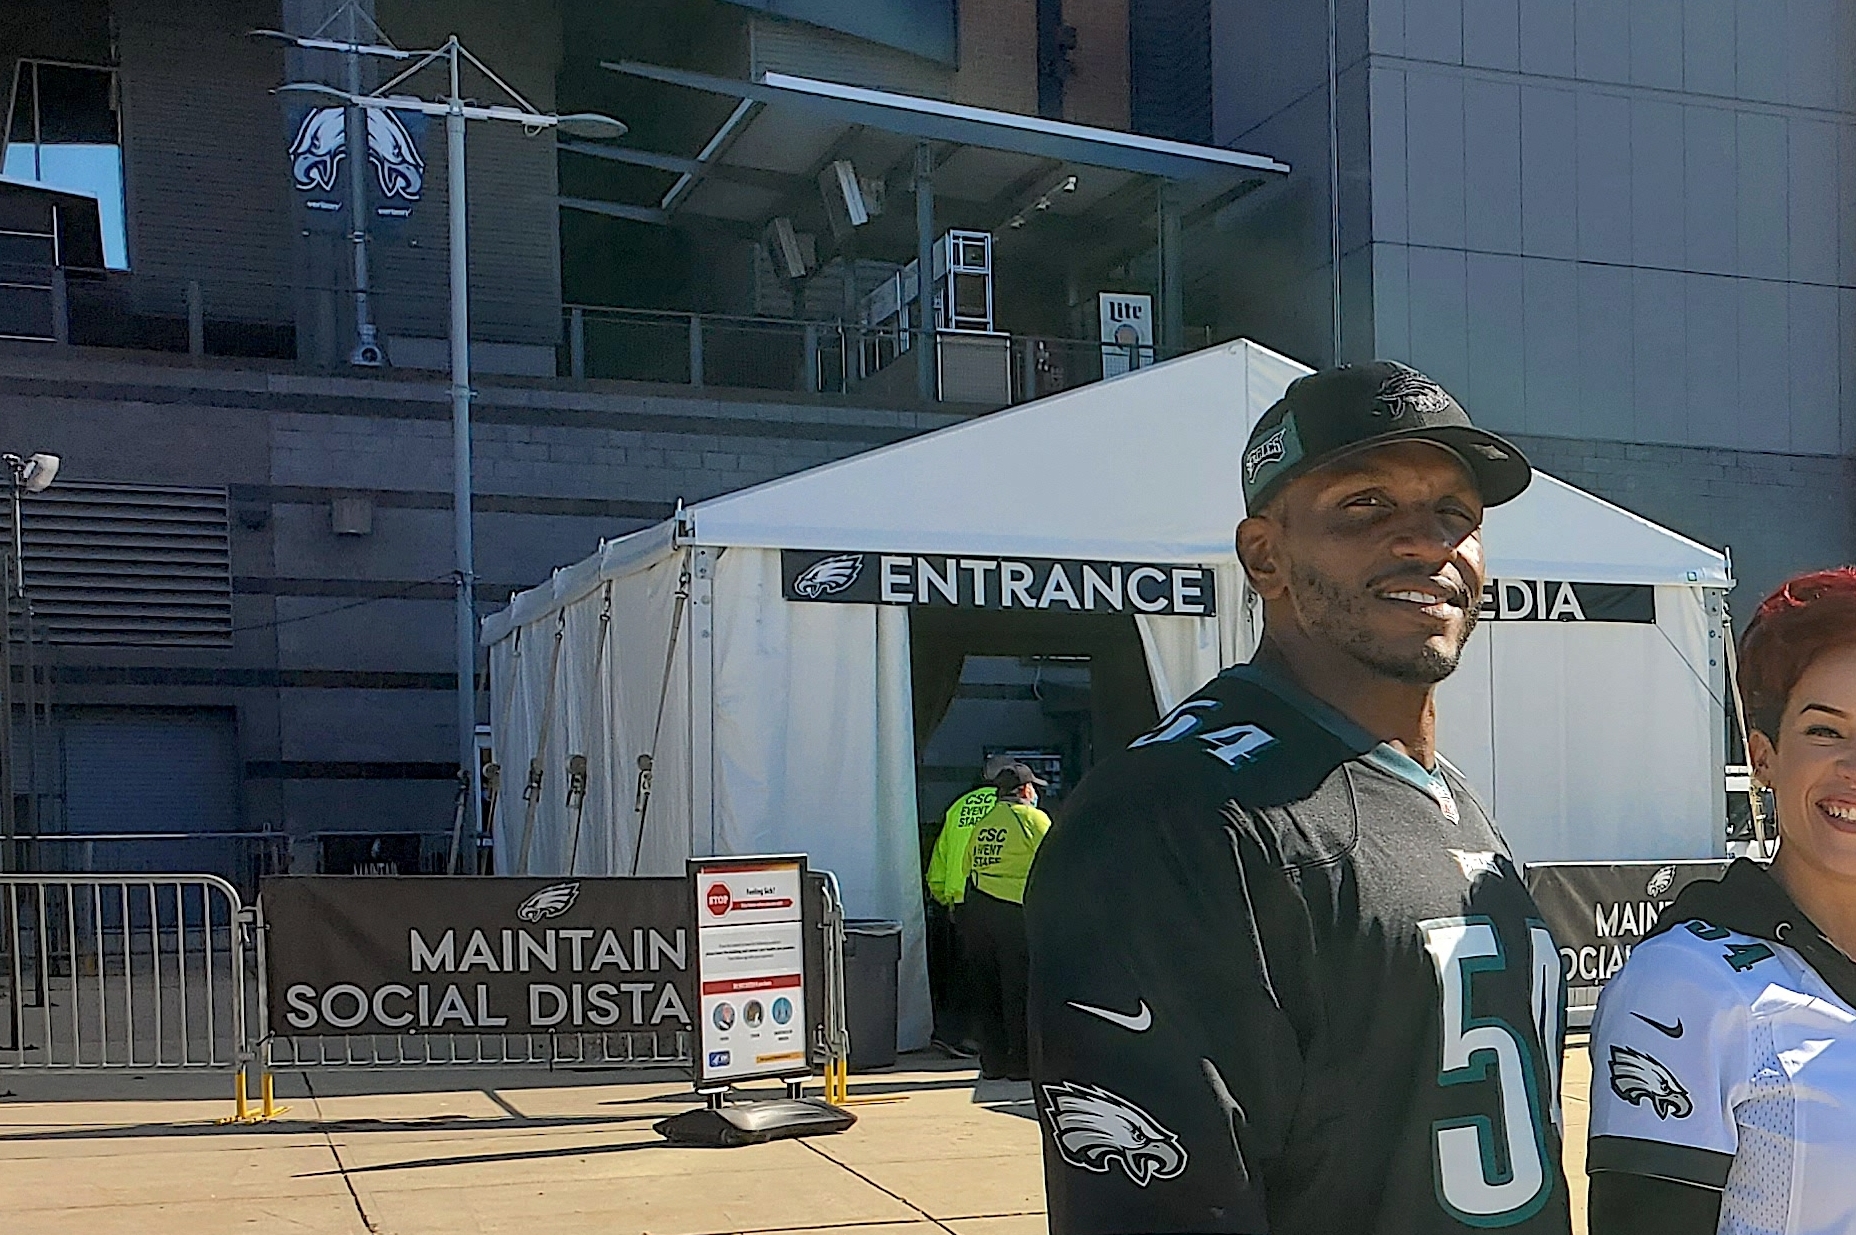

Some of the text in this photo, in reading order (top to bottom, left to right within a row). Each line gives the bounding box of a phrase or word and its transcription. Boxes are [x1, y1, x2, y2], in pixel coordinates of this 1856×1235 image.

[1109, 301, 1142, 323] Lite
[879, 555, 1206, 613] ENTRANCE
[966, 793, 996, 805] CSC
[977, 828, 1008, 843] CSC
[410, 928, 687, 972] MAINTAIN
[286, 983, 508, 1027] SOCIAL
